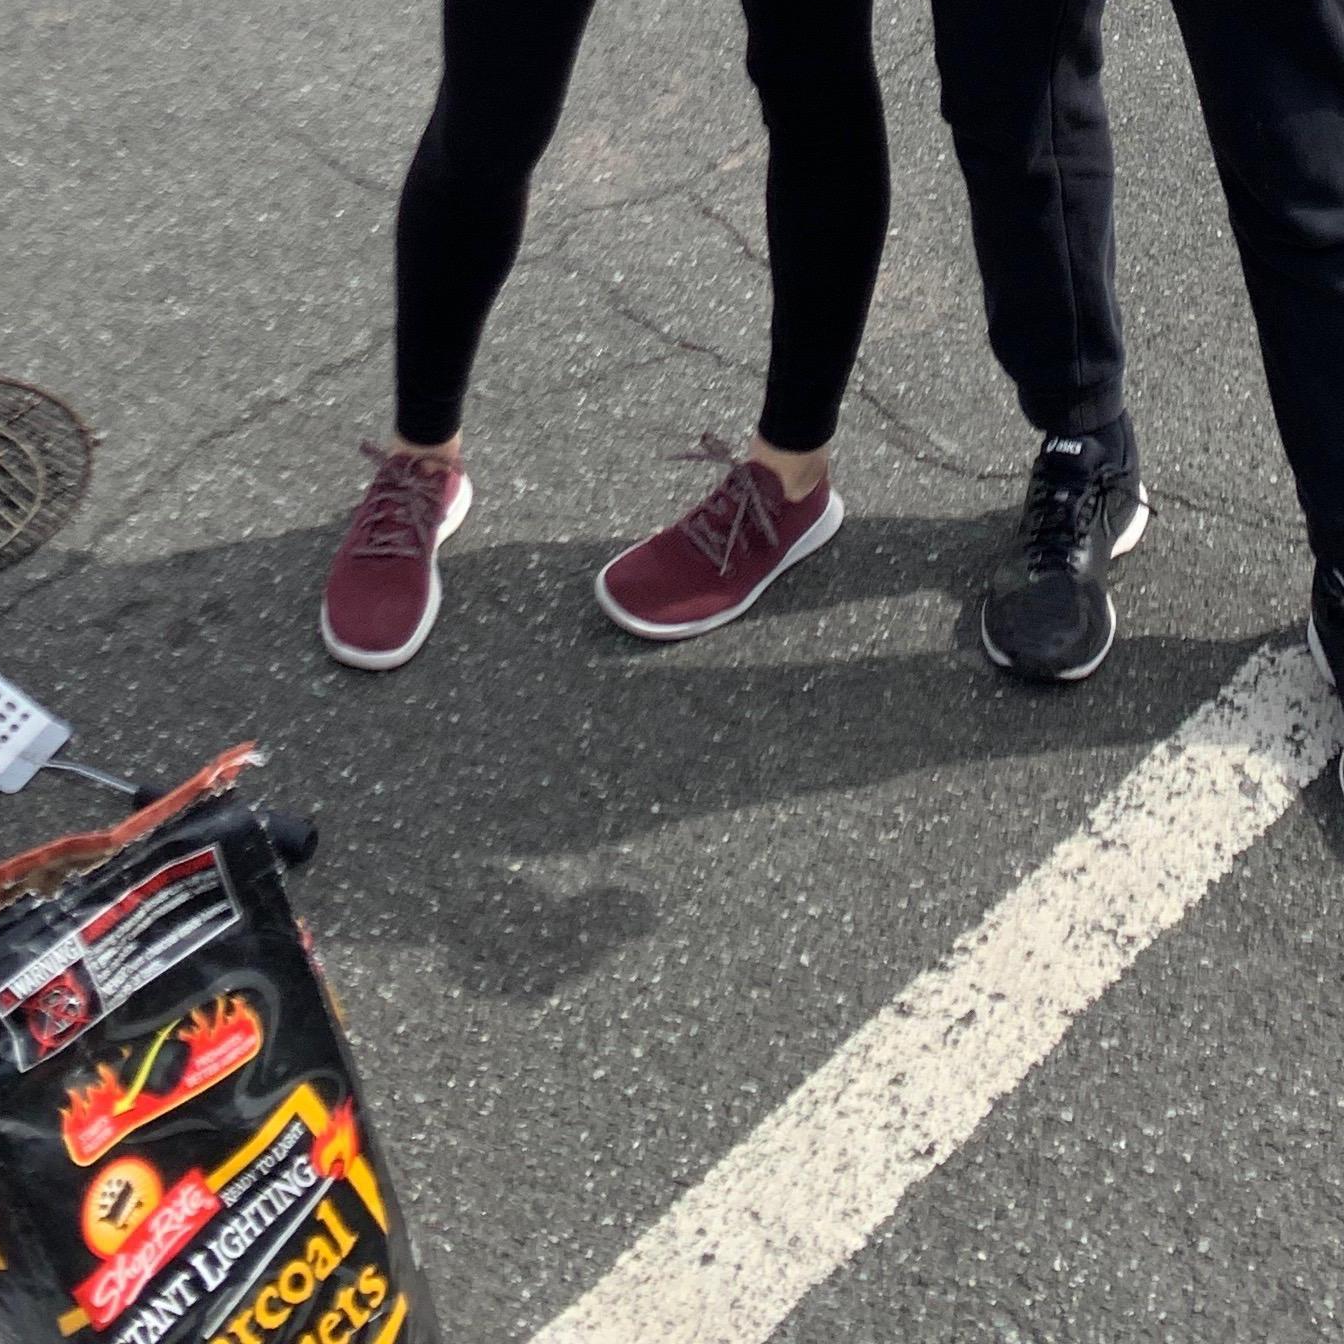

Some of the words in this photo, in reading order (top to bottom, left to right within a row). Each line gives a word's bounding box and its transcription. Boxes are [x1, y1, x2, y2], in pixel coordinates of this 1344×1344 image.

[10, 937, 80, 1000] WARNING
[256, 1154, 276, 1175] TO
[189, 1153, 318, 1292] LIGHTING
